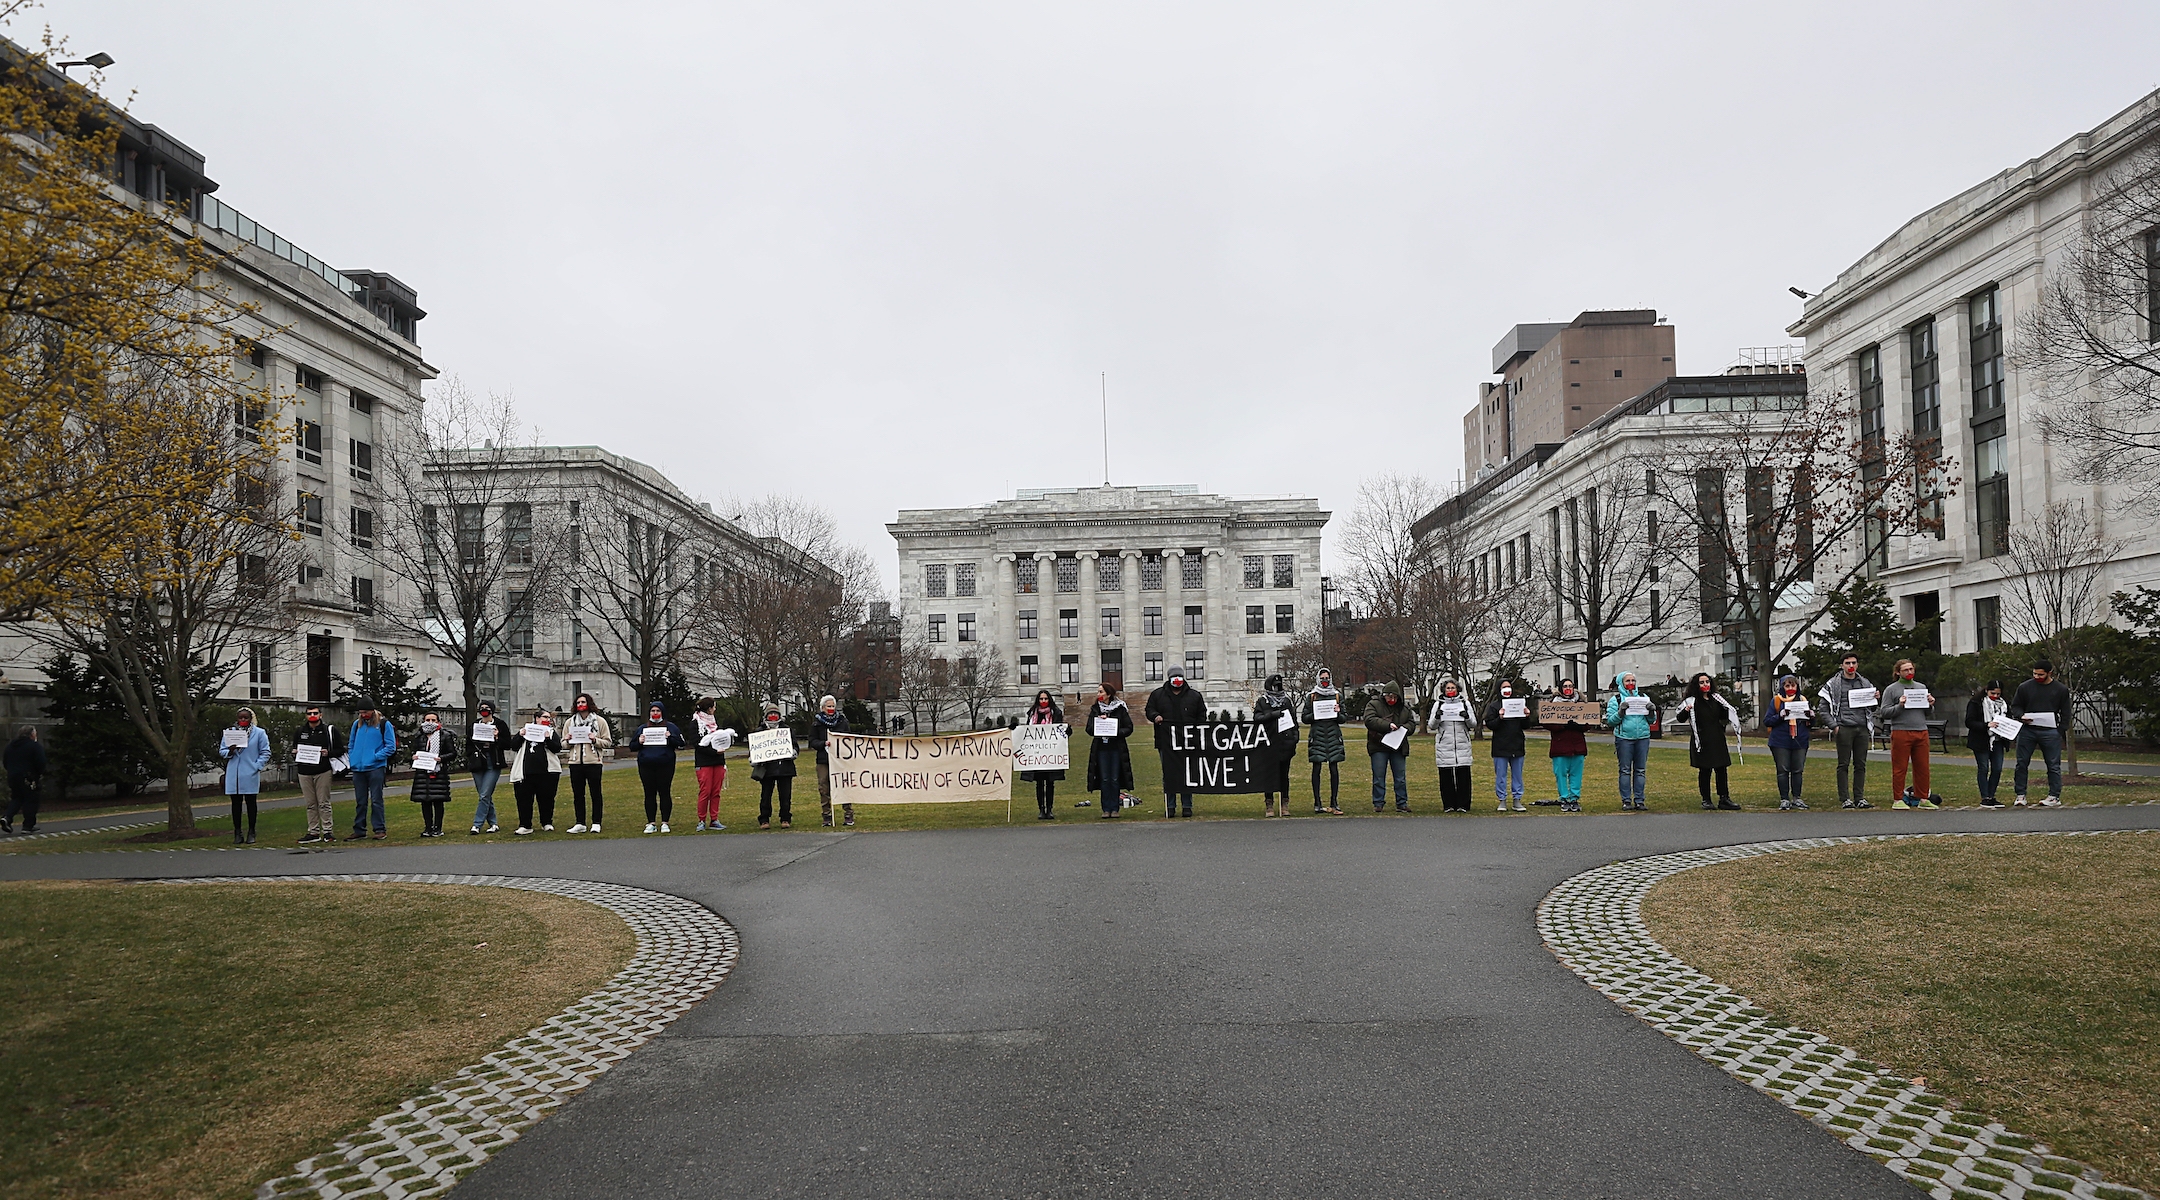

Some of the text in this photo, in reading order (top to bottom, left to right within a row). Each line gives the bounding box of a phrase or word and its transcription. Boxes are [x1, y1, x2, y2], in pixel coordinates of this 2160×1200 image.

[1023, 727, 1058, 740] AMA
[1171, 724, 1270, 750] LET GAZA
[751, 738, 790, 750] ANESTHESIA
[765, 747, 791, 758] GAZA
[836, 736, 1012, 760] ISRAEL IS STARVING
[1018, 754, 1068, 766] GENOCIDE
[831, 768, 1004, 791] THE CHILDREN OF GAZA
[1185, 757, 1236, 787] LIVE
